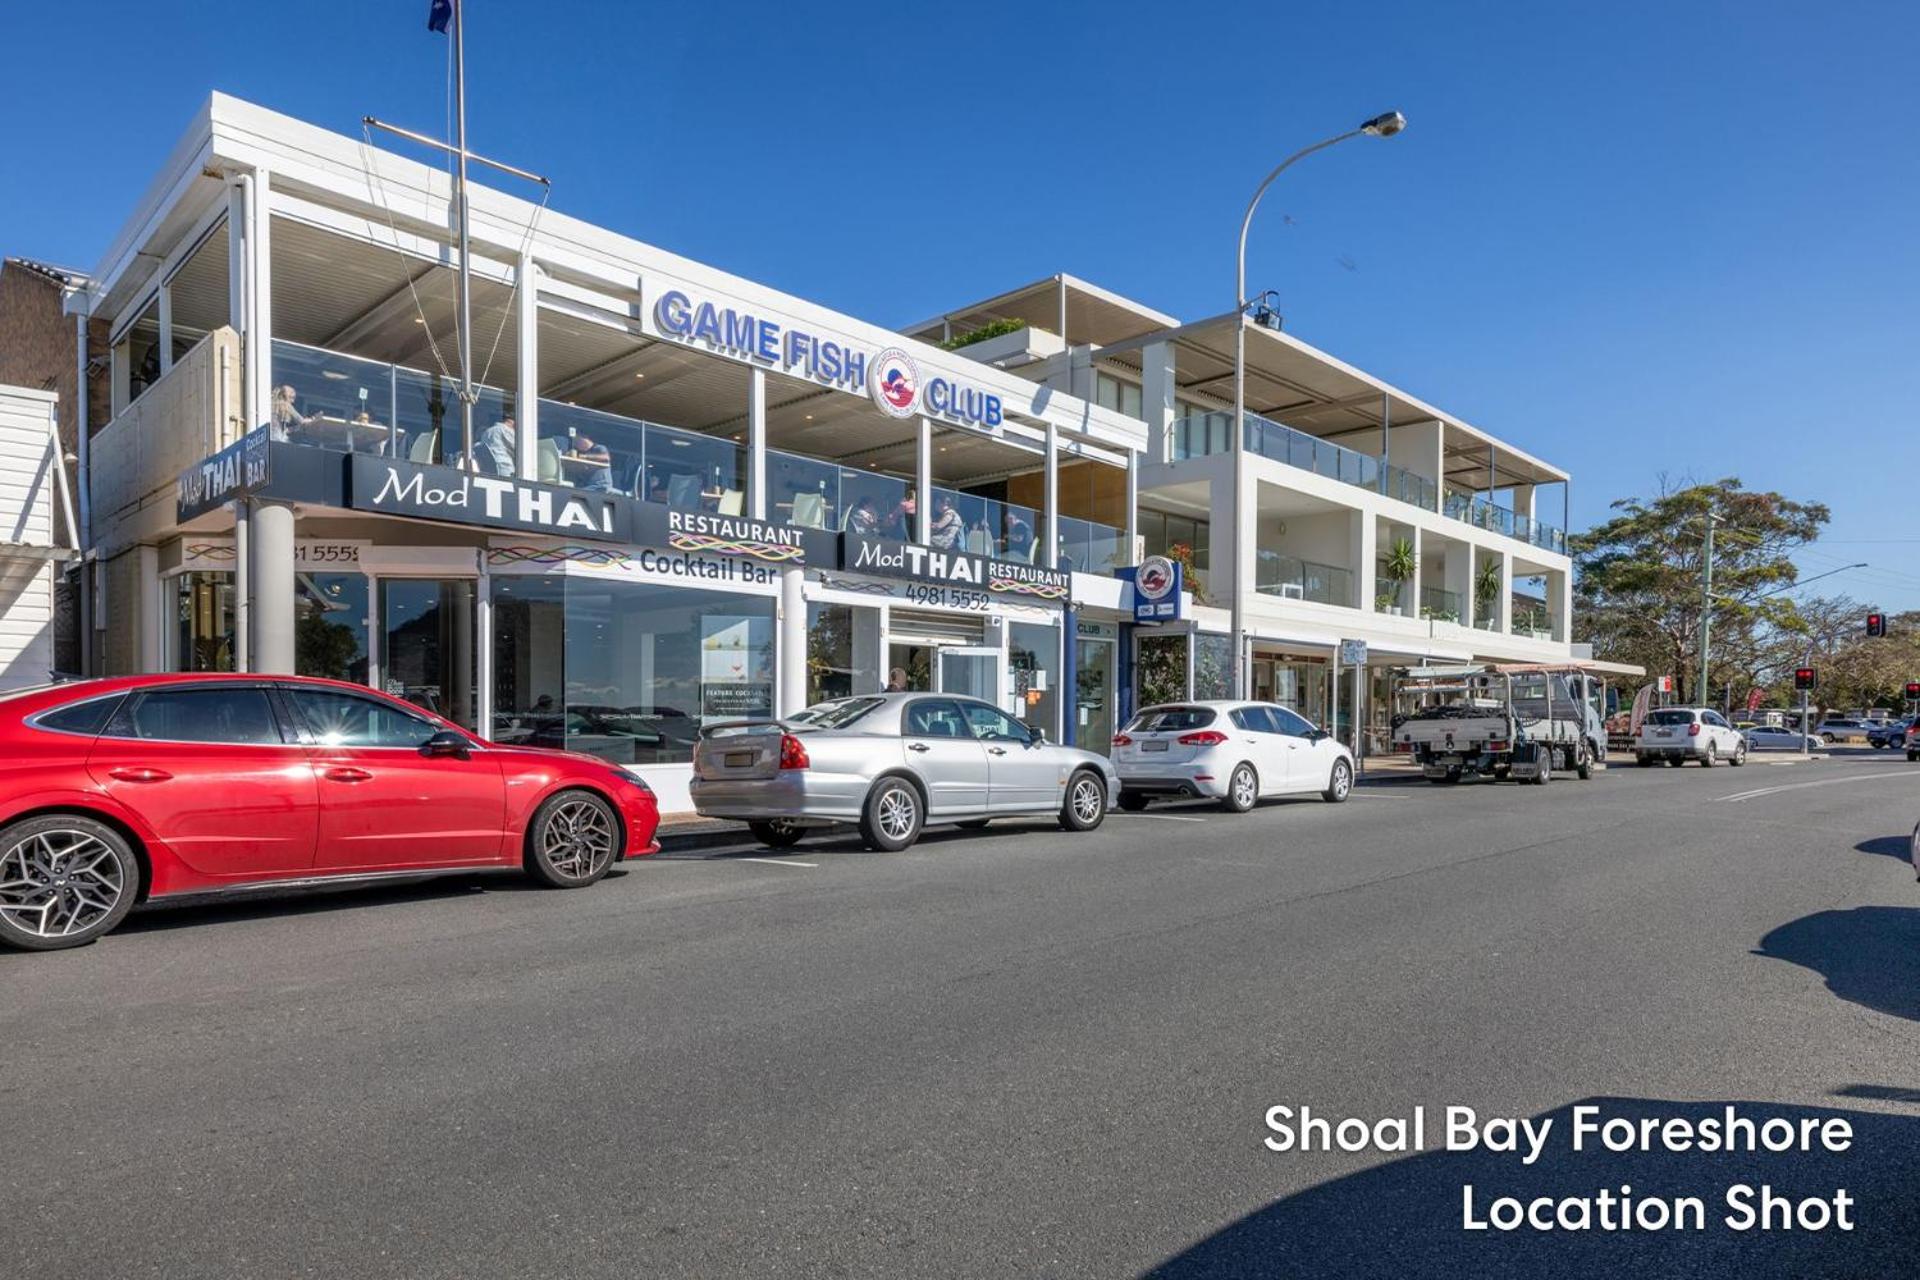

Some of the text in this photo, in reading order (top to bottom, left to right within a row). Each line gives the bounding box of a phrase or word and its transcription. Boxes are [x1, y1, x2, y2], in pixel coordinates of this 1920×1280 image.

[656, 290, 781, 363] GAME
[787, 329, 865, 388] FISH
[927, 377, 1002, 427] CLUB
[202, 450, 242, 501] THAI
[247, 458, 267, 488] BAR
[373, 467, 614, 534] Mod THAI
[668, 511, 804, 547] RESTAURANT
[640, 549, 777, 585] Cocktail Bar
[855, 541, 1070, 588] Mod THAI RESTAURANT
[905, 583, 991, 612] 4981 5552
[1077, 623, 1101, 635] CLUB
